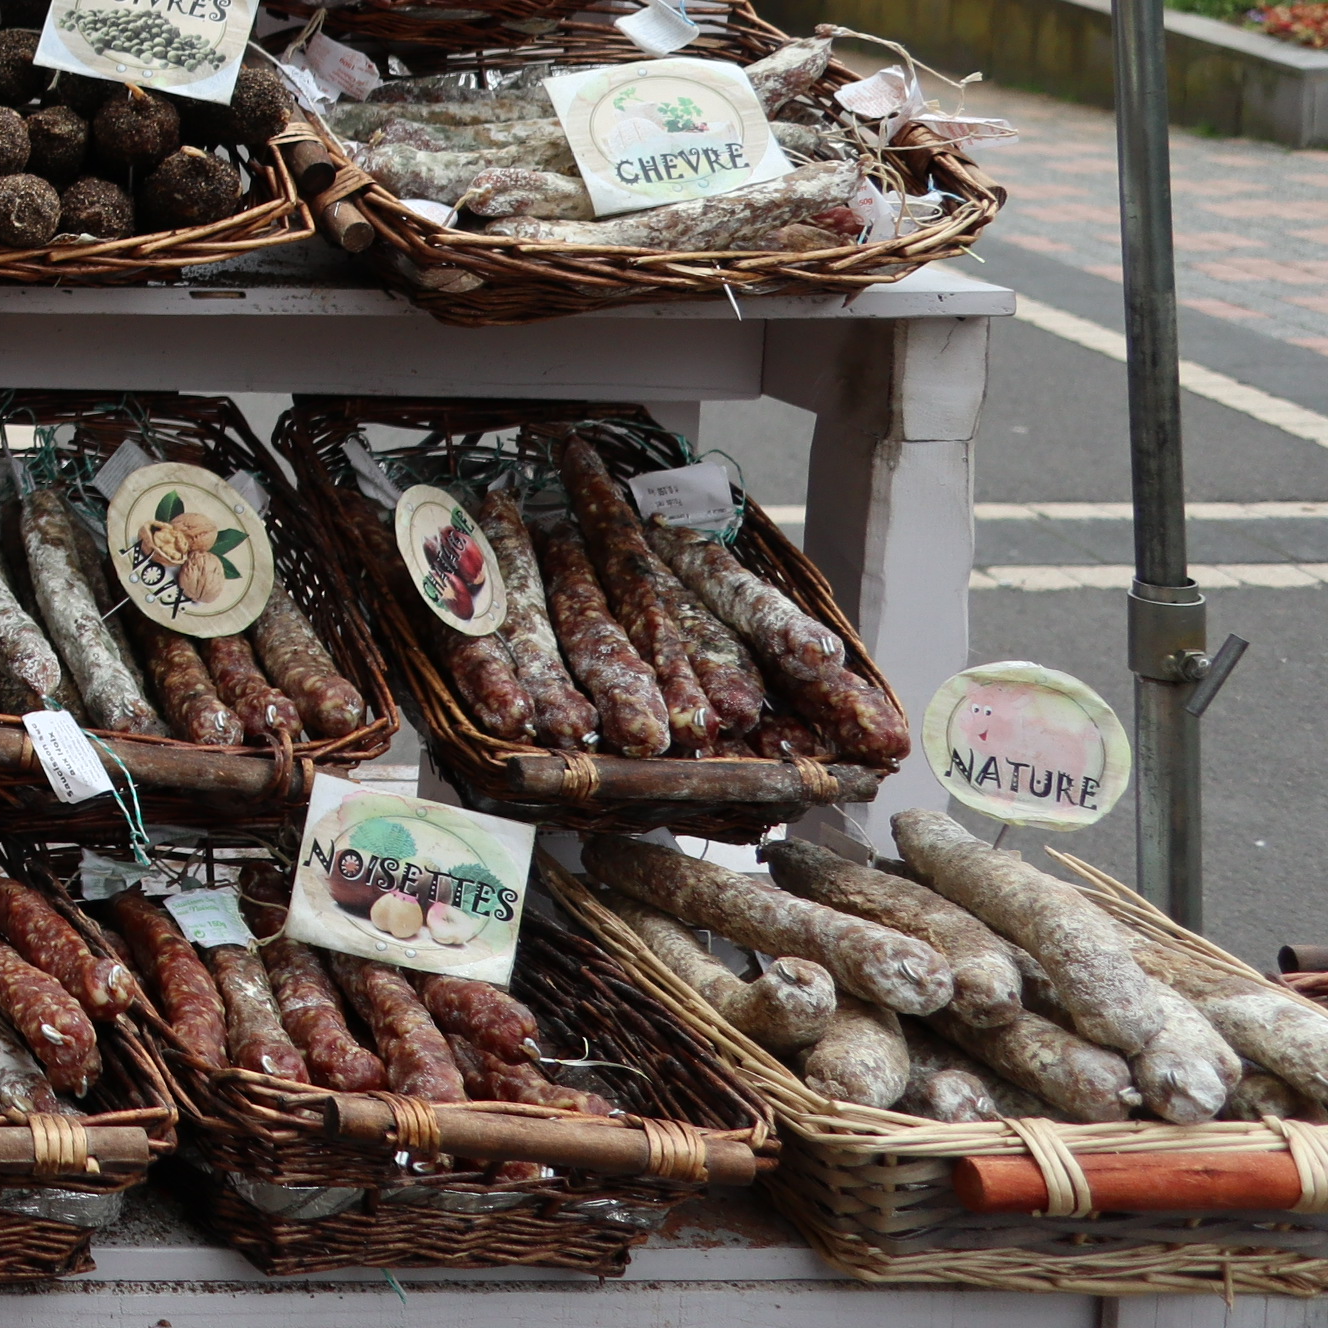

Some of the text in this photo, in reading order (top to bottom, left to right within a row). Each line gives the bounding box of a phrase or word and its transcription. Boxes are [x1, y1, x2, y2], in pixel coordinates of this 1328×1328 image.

[615, 141, 751, 187] CHEVRE
[119, 539, 193, 621] NOIX
[944, 747, 1102, 811] NATURE
[302, 837, 520, 923] NOISETTES
